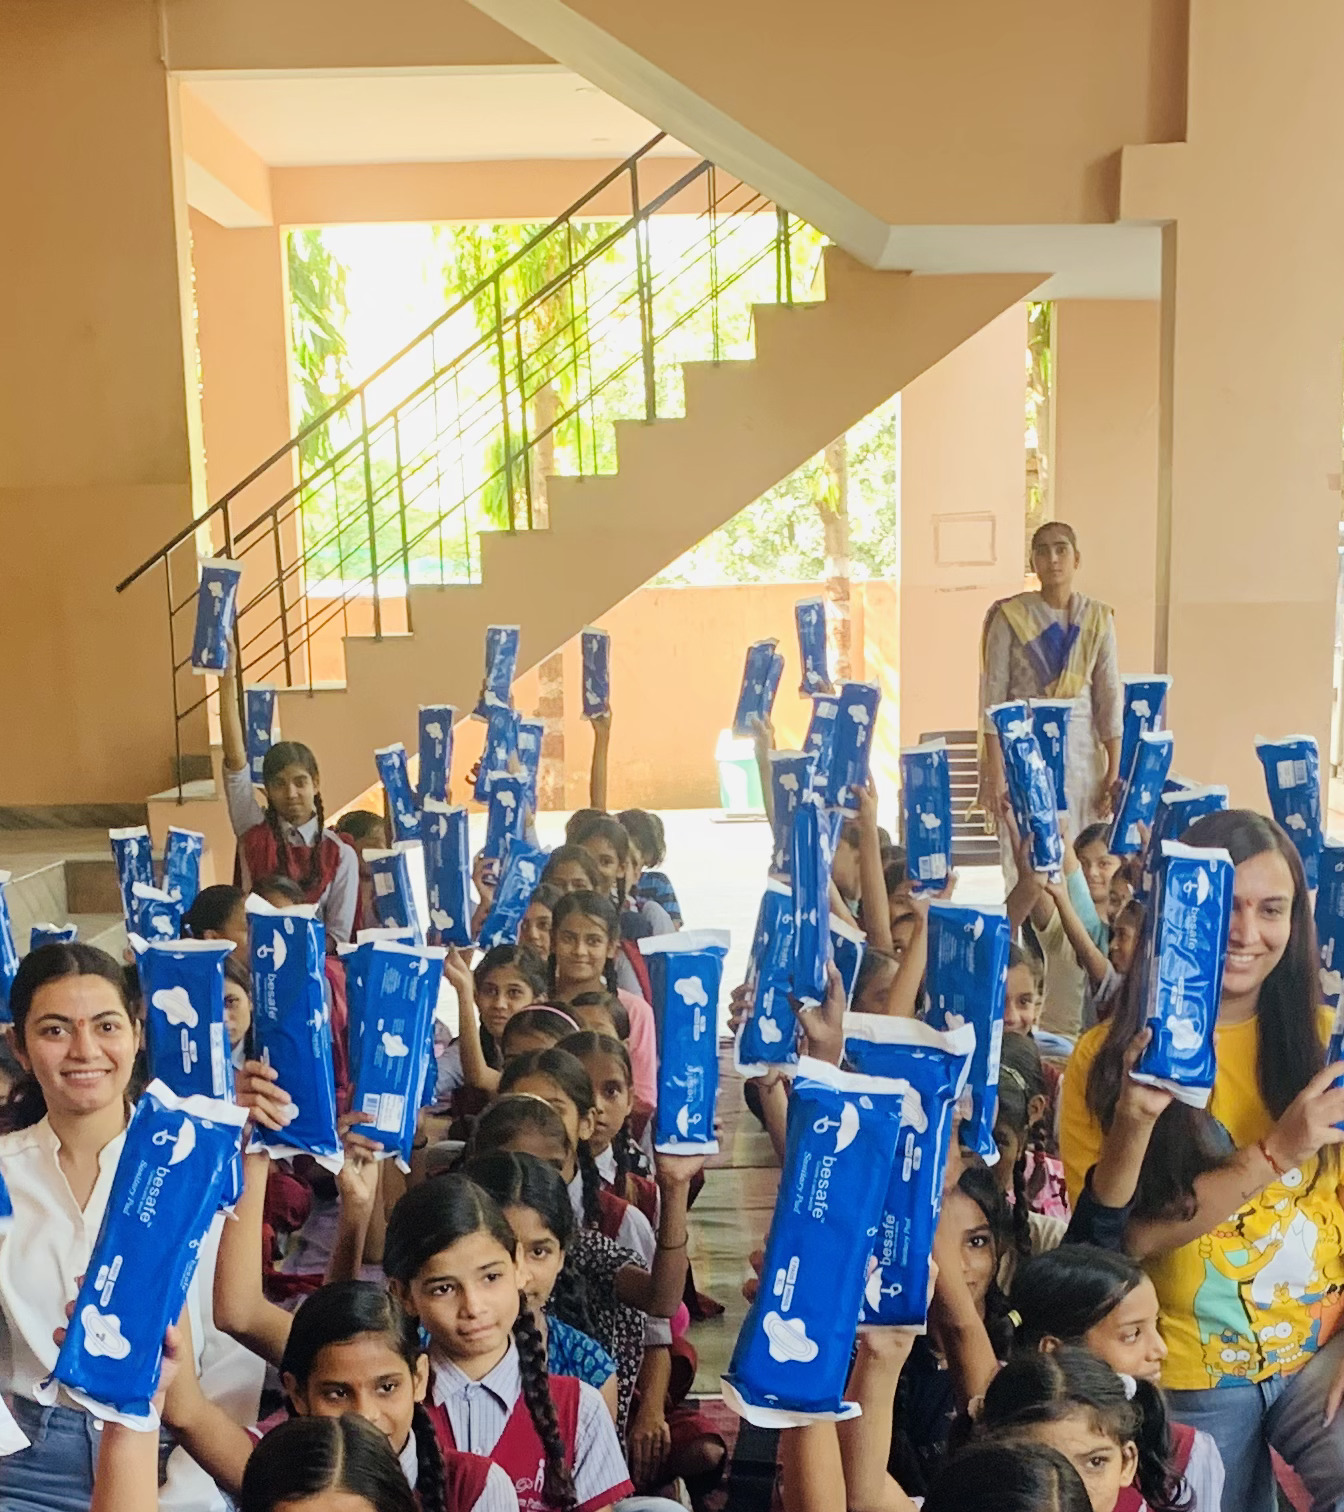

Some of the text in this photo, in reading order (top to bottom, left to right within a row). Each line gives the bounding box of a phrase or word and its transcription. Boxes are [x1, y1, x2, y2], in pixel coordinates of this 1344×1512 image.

[138, 1165, 171, 1224] besafe
[811, 1155, 837, 1220] besafe
[880, 1212, 896, 1267] besafe
